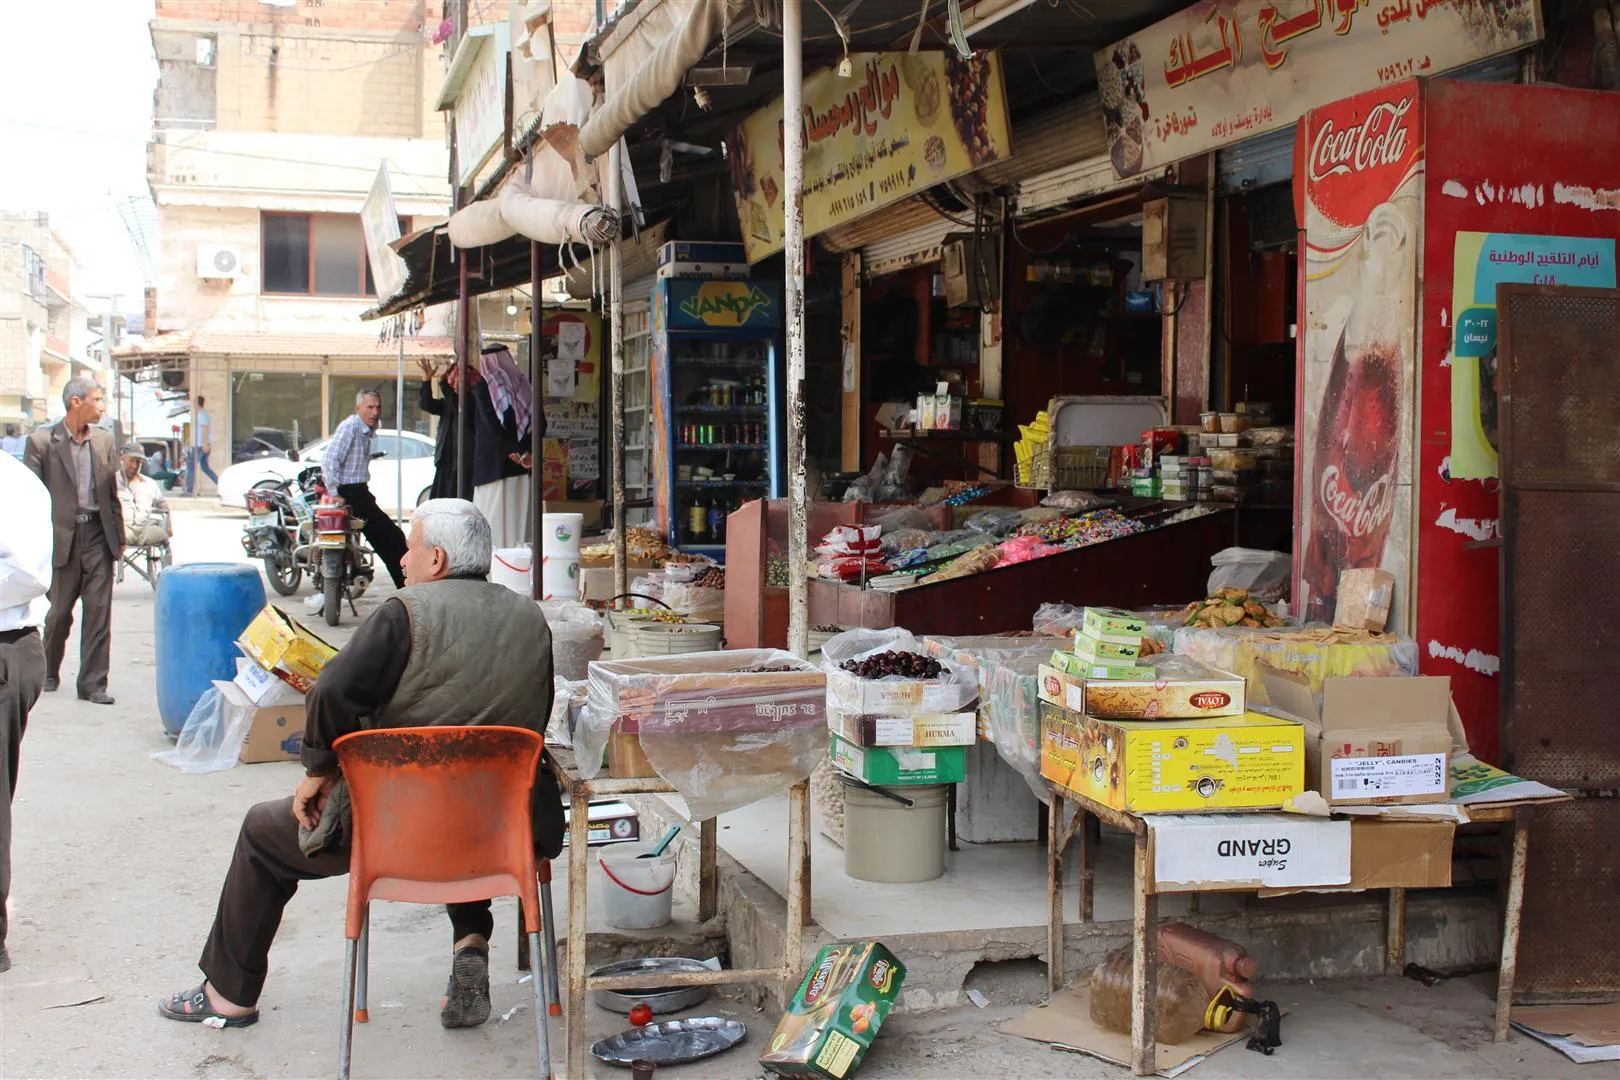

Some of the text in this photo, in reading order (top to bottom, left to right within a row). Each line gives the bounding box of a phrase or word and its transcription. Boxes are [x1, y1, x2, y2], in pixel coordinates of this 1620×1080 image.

[1309, 97, 1415, 182] Coca-Cola
[1489, 249, 1599, 269] أيام التلقيح الوطنية
[1464, 333, 1489, 344] نيسان
[1434, 757, 1442, 785] 5222
[1217, 837, 1291, 857] GRAND
[1256, 858, 1288, 871] Super
